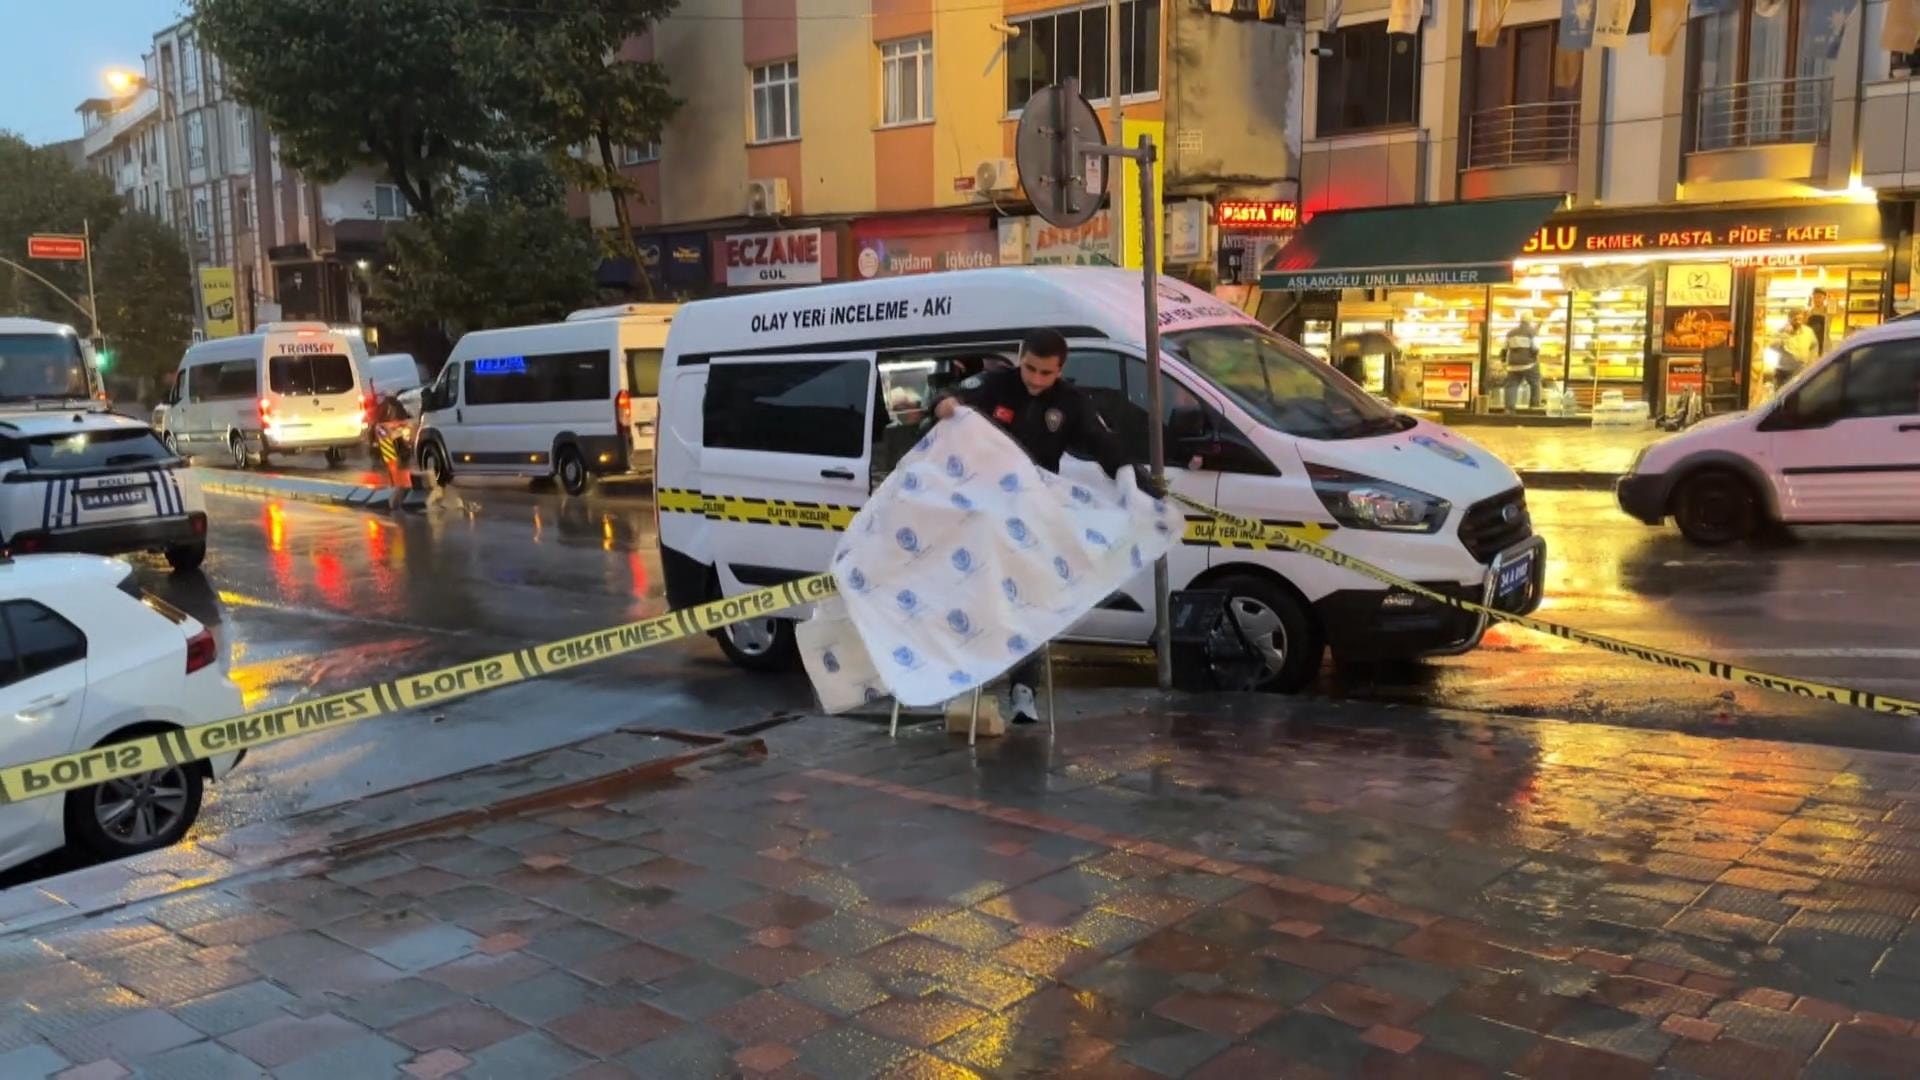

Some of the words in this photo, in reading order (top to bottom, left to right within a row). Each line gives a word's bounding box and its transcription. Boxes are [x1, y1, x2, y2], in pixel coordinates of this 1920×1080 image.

[1223, 206, 1267, 221] PASTA
[1586, 234, 1644, 249] EKMEK
[1658, 231, 1713, 247] PASTA
[1728, 225, 1772, 244] PİDE
[1786, 225, 1839, 242] KAFE
[727, 233, 818, 267] ECZANE
[751, 311, 788, 333] OLAY
[279, 343, 335, 354] TRANSAY
